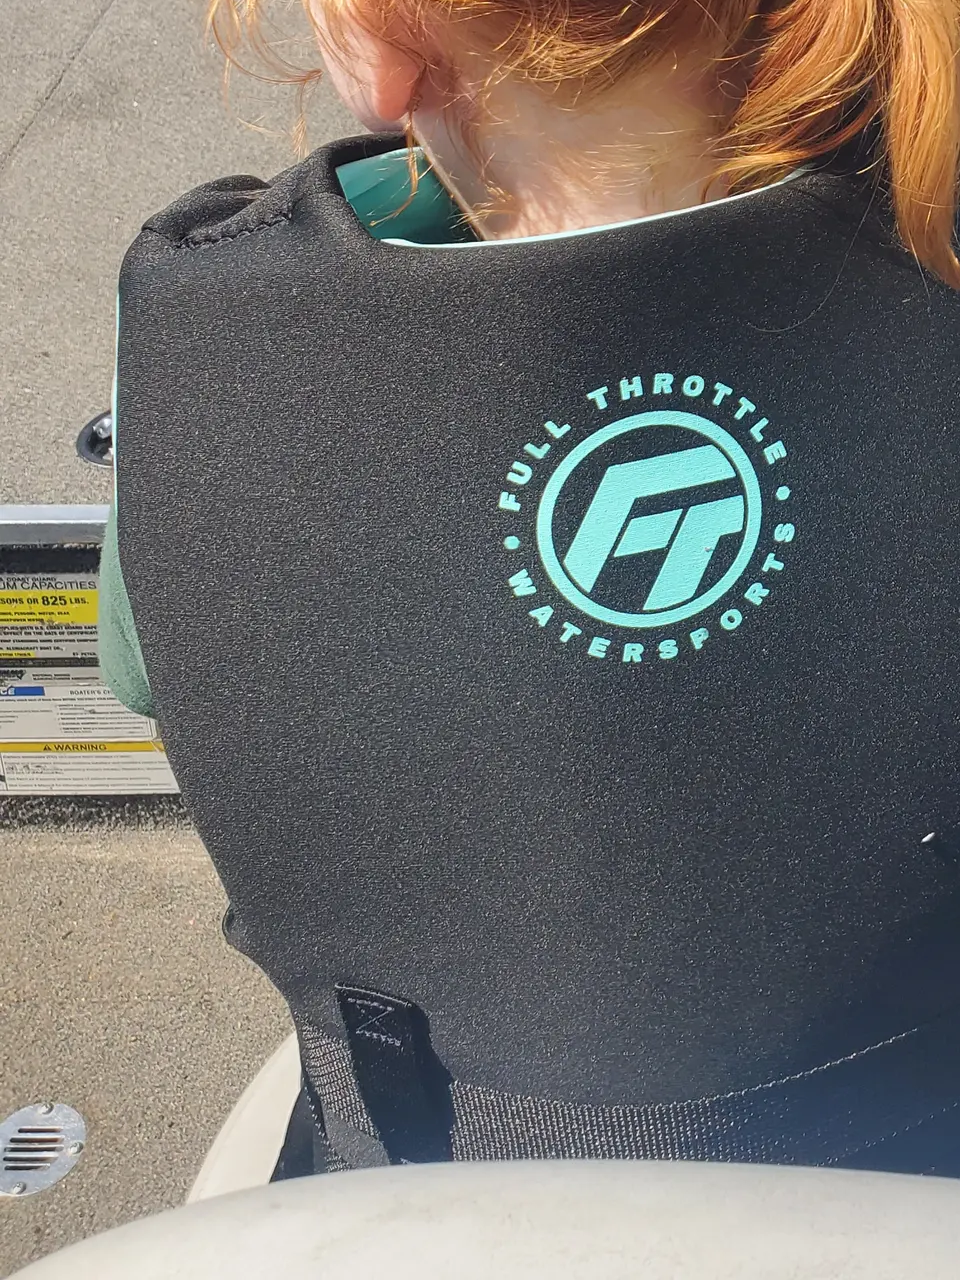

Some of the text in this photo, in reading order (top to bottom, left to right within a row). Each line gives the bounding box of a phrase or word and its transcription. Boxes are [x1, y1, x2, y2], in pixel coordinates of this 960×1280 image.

[499, 372, 788, 512] FULL THROTTLE
[20, 580, 97, 590] CAPACITIES
[507, 521, 796, 664] WATERSPORTS
[41, 595, 67, 606] 825
[54, 743, 107, 752] WARNING
